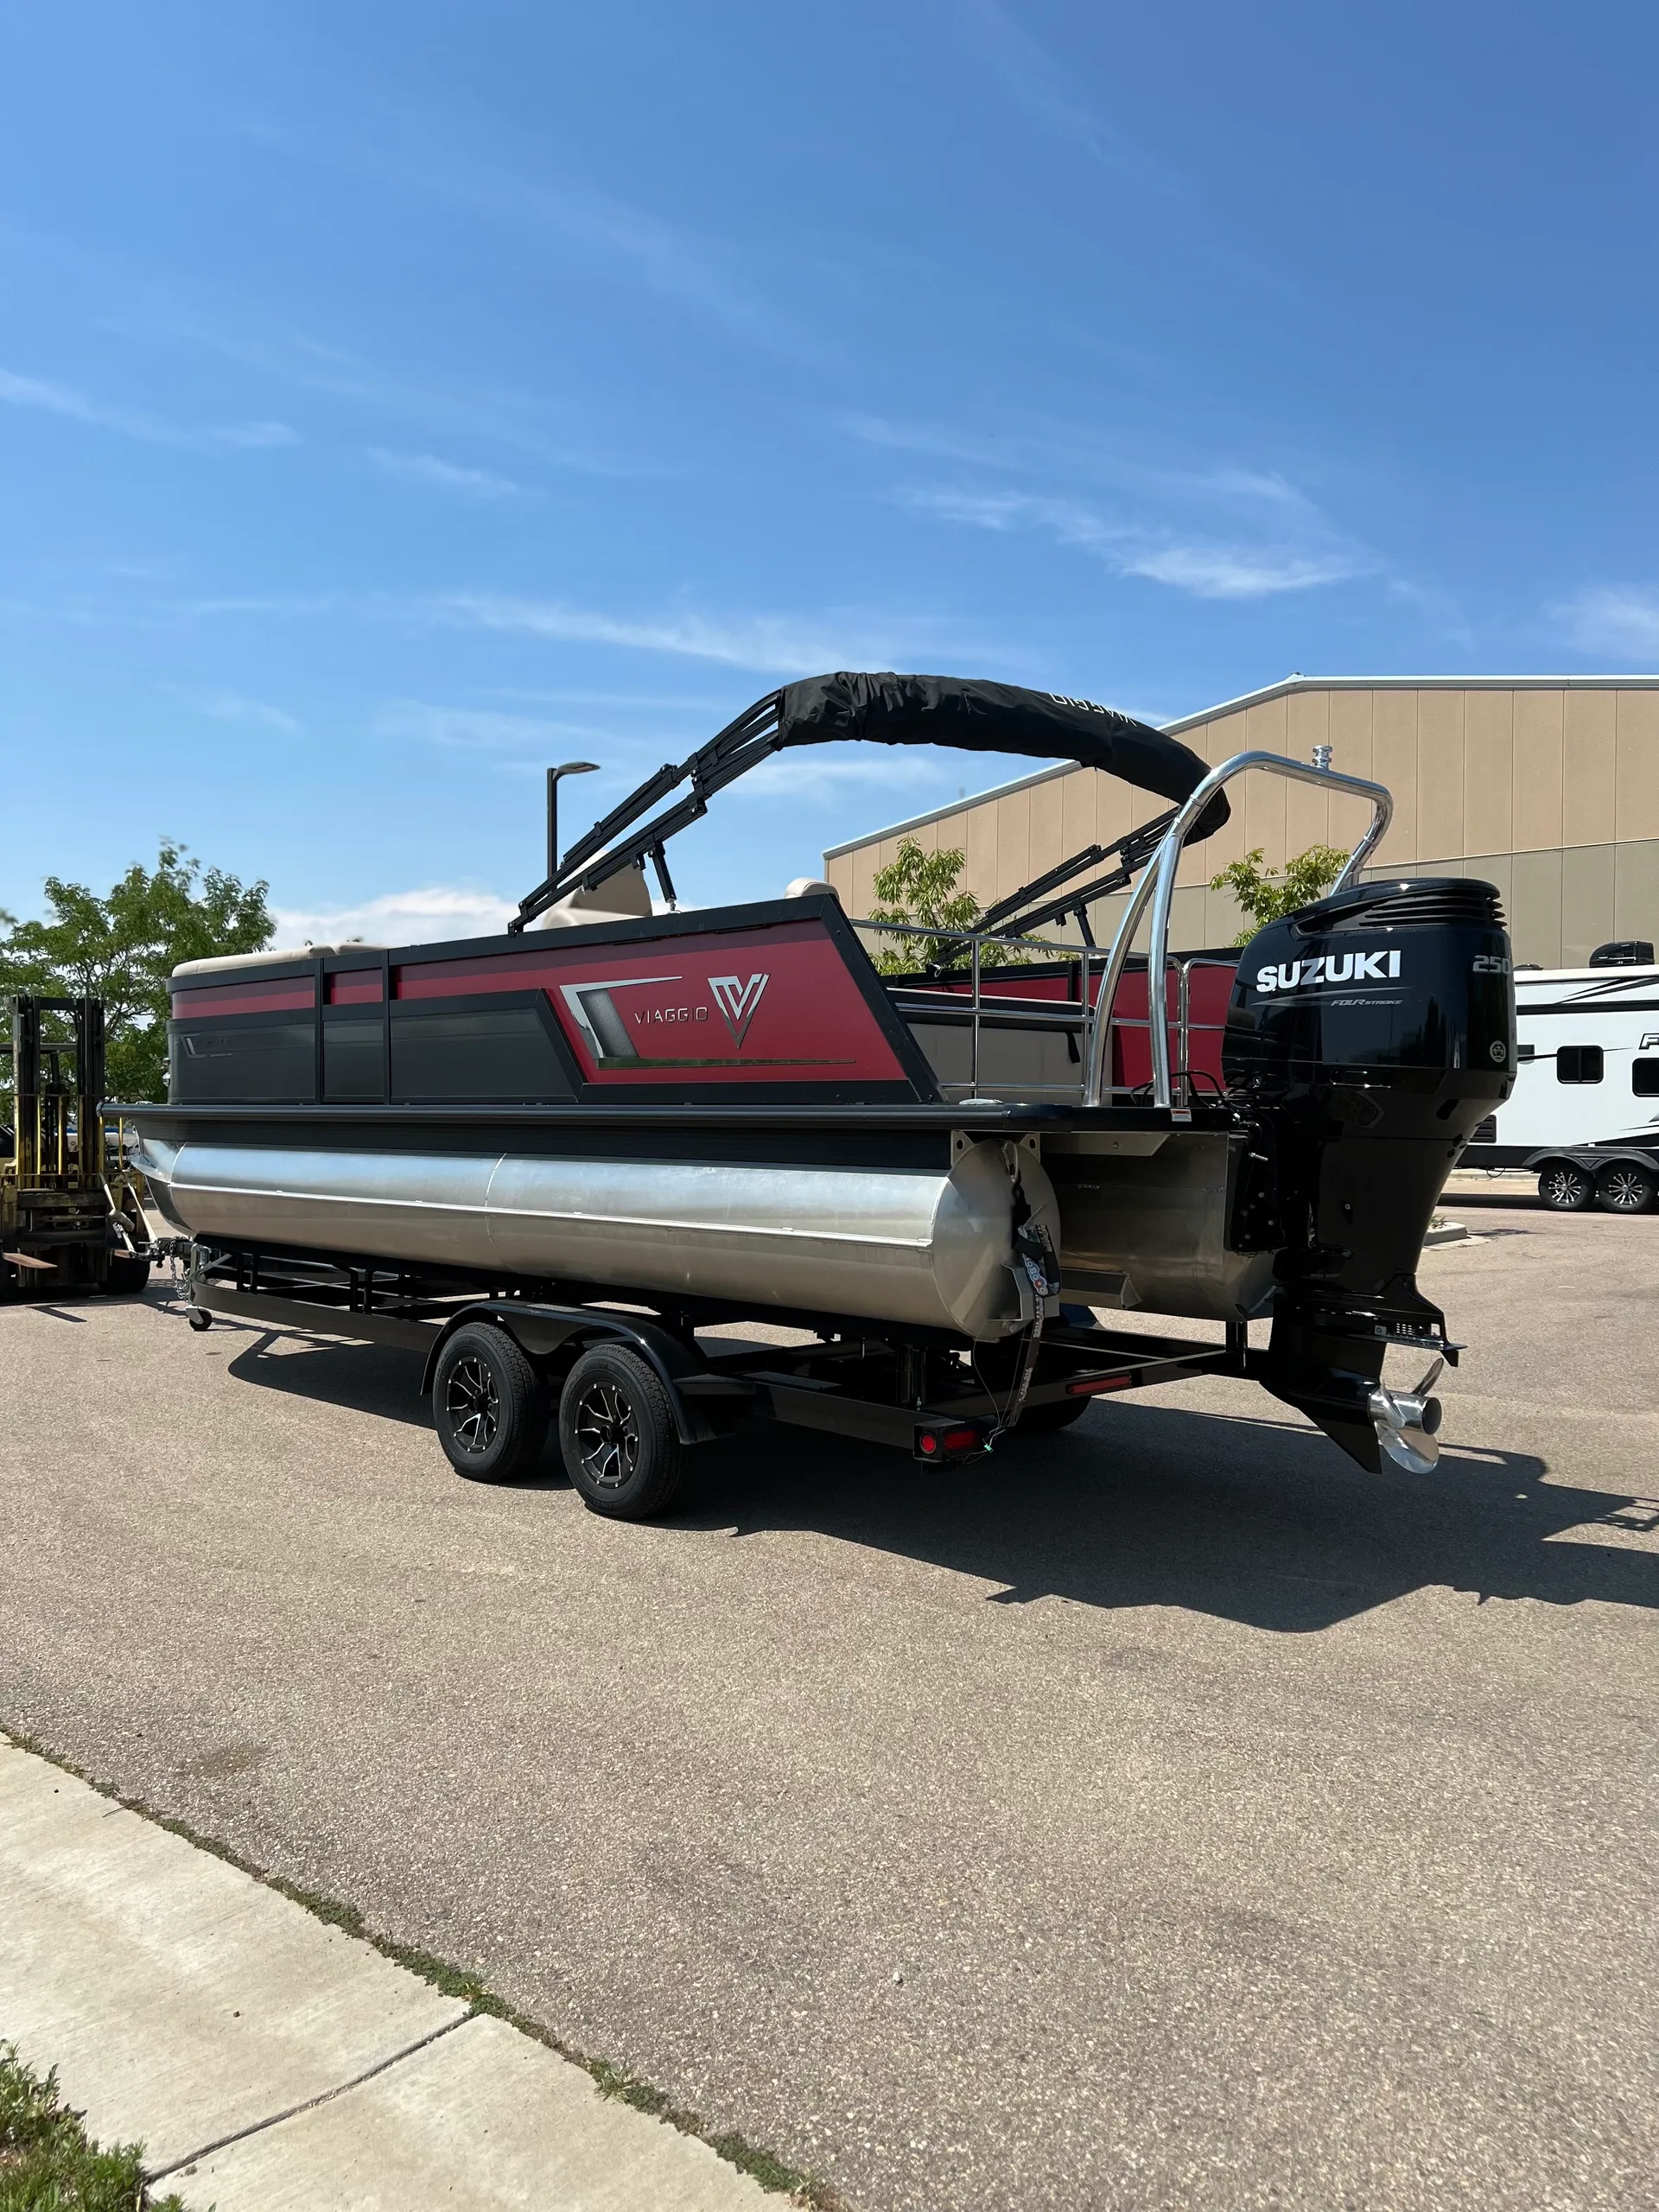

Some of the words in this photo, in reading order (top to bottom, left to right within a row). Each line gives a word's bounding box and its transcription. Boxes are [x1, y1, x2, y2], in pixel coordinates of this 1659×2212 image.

[1256, 950, 1402, 993] SUZUKI
[1472, 955, 1510, 974] 250
[634, 1007, 709, 1024] VIAGGIO
